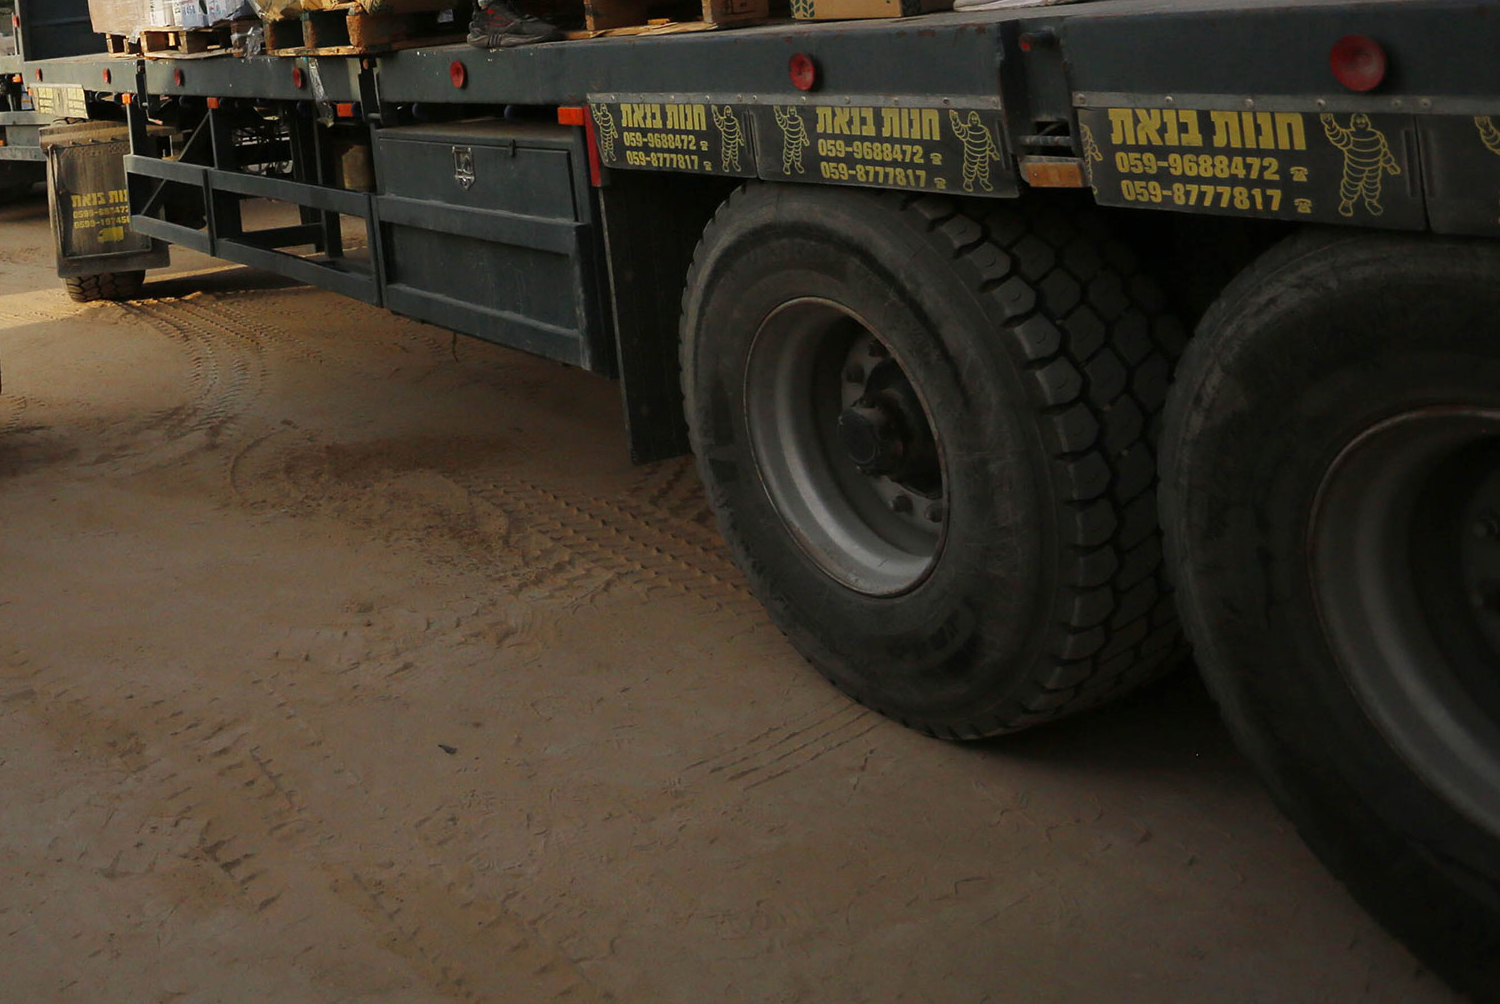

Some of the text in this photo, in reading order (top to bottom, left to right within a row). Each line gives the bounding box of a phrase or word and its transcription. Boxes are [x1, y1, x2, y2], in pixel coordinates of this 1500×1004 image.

[620, 103, 707, 131] חנות בנאת
[815, 106, 941, 141] חנות בנאת
[1107, 108, 1307, 151] חנות בנאת
[623, 132, 697, 151] 059-9688472
[817, 139, 925, 164] 059-9688472
[626, 151, 699, 170] 059-8777817
[820, 161, 927, 187] 059-8777817
[1115, 151, 1281, 181] 059-9688472
[108, 189, 128, 204] נות
[1120, 179, 1282, 212] 059-8777817
